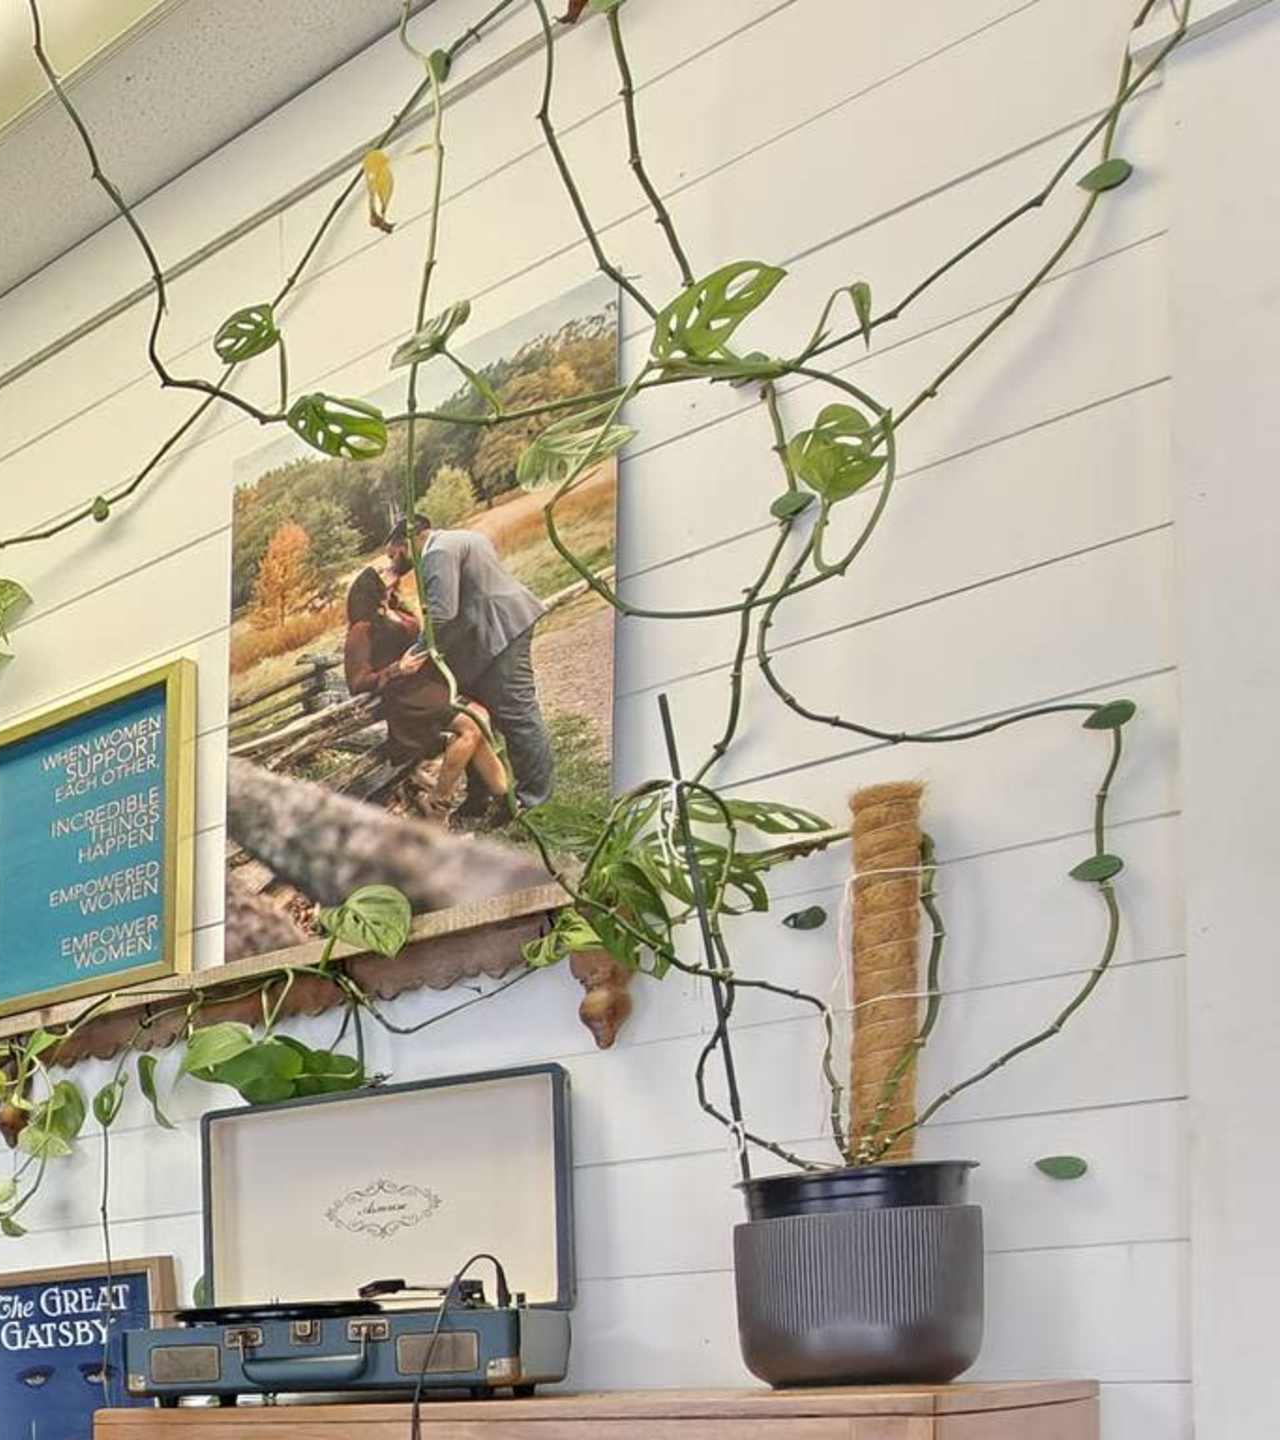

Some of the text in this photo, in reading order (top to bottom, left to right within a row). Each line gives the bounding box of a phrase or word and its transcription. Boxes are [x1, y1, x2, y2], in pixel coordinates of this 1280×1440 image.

[42, 714, 160, 771] WHEN WOMEN
[66, 731, 160, 783] SUPPORT
[55, 776, 97, 803] EACH
[50, 786, 160, 838] INCREDIBLE
[88, 804, 160, 843] THINGS
[48, 861, 160, 907] EMPOWERED
[80, 877, 159, 915] WOMEN
[61, 914, 158, 956] EMPOWER
[40, 1284, 130, 1317] GREAT
[0, 1317, 116, 1350] GATSBY
